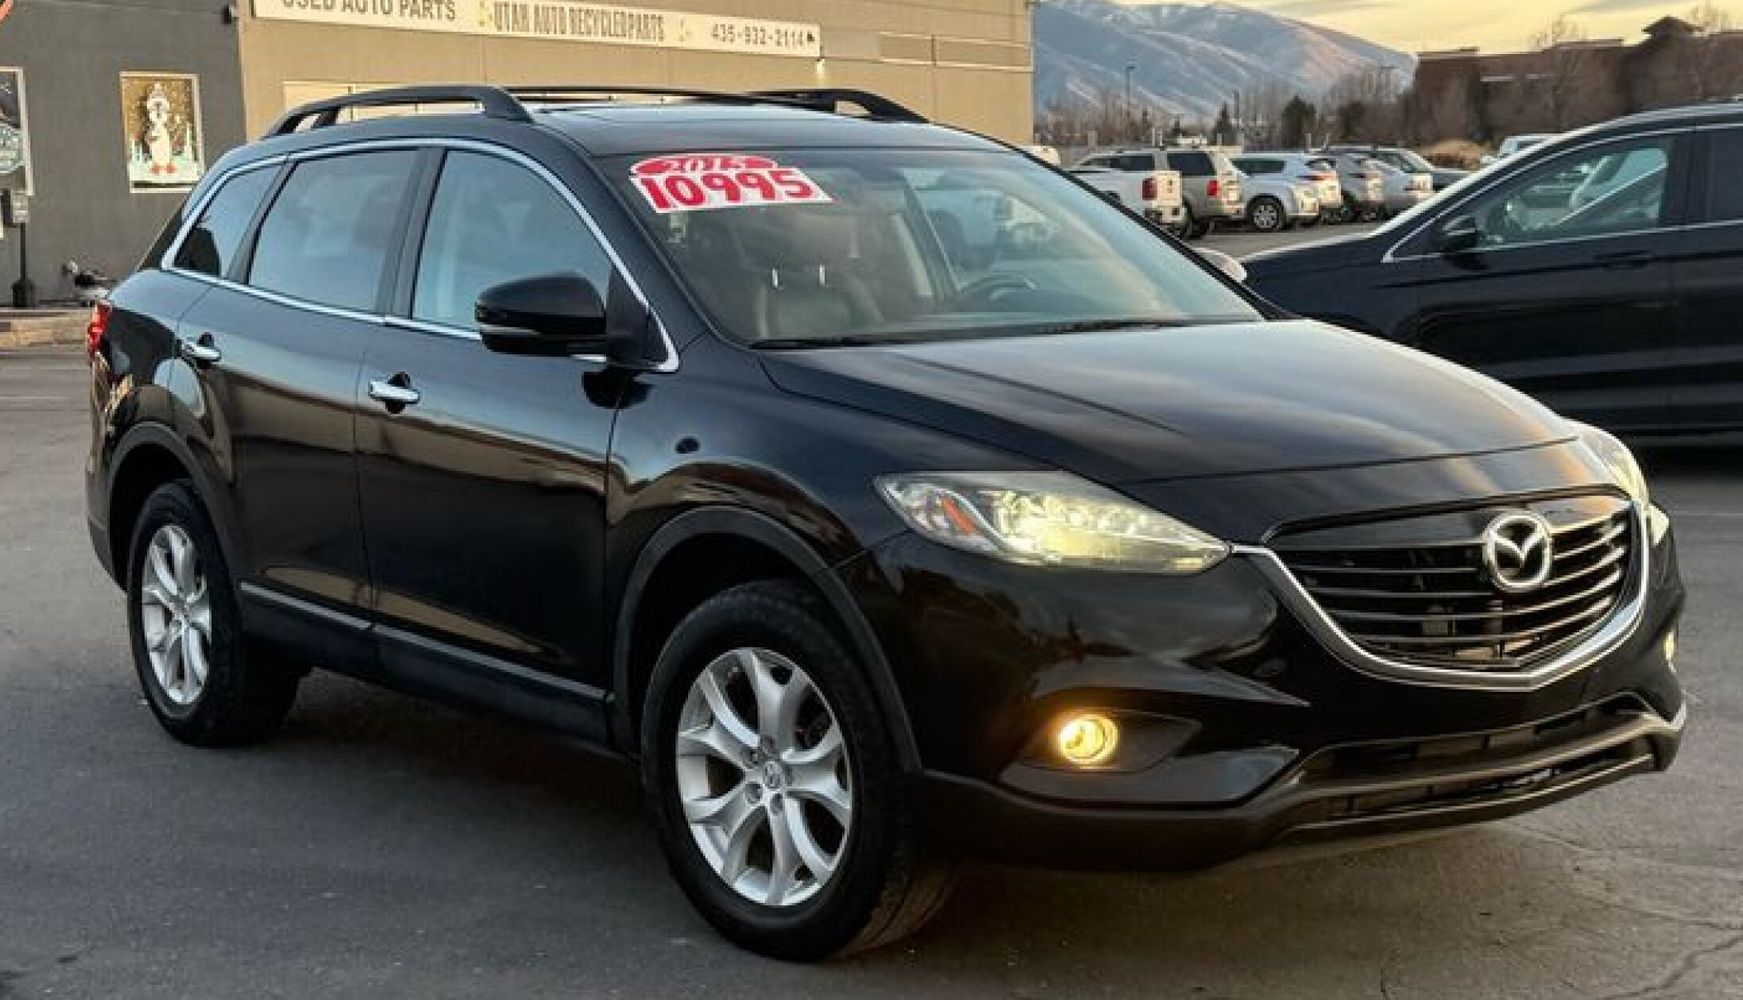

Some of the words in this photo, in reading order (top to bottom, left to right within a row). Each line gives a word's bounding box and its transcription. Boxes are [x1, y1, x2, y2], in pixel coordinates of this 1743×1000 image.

[340, 0, 393, 15] AUTO
[399, 0, 457, 21] PARTS
[494, 1, 530, 32] UTAH
[533, 3, 567, 35] AUTO
[640, 170, 814, 209] 10995
